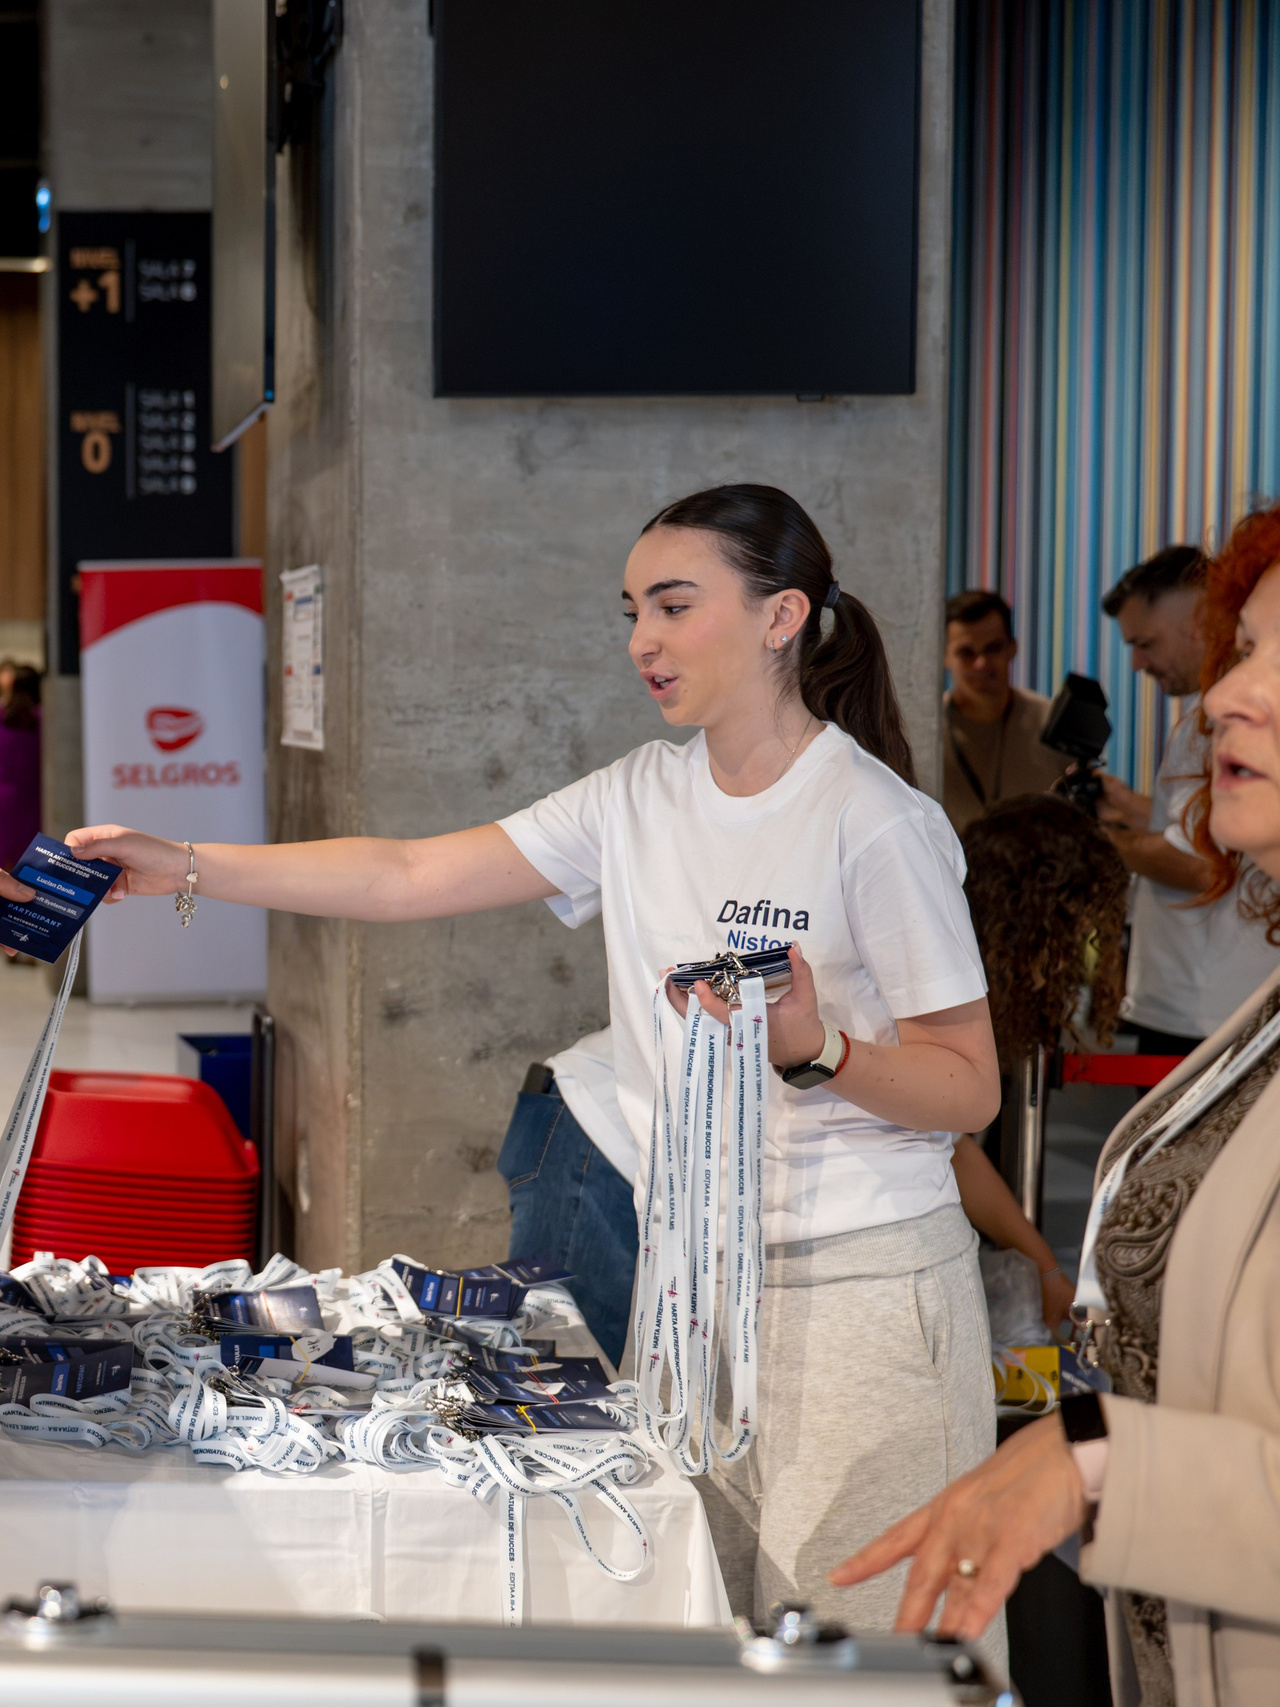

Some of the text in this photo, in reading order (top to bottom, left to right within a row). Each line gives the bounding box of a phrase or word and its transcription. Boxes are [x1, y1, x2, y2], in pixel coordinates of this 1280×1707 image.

[70, 270, 120, 314] +1
[81, 431, 112, 475] 0
[112, 761, 241, 789] SELGROS
[35, 846, 54, 857] HARTA
[55, 860, 76, 873] SUCCES
[8, 903, 62, 928] PARTICIPANT
[717, 900, 810, 931] Dafina
[690, 1037, 696, 1048] DE
[686, 1048, 695, 1077] SUCCES
[706, 1041, 715, 1119] ANTREPRENORIATULUI
[706, 1120, 712, 1130] DE
[16, 1143, 26, 1164] HARTA
[738, 1157, 744, 1167] DE
[3, 1191, 12, 1208] FILMS
[653, 1328, 661, 1348] HARTA
[591, 1479, 627, 1516] ANTREPRENO
[508, 1522, 515, 1532] DE
